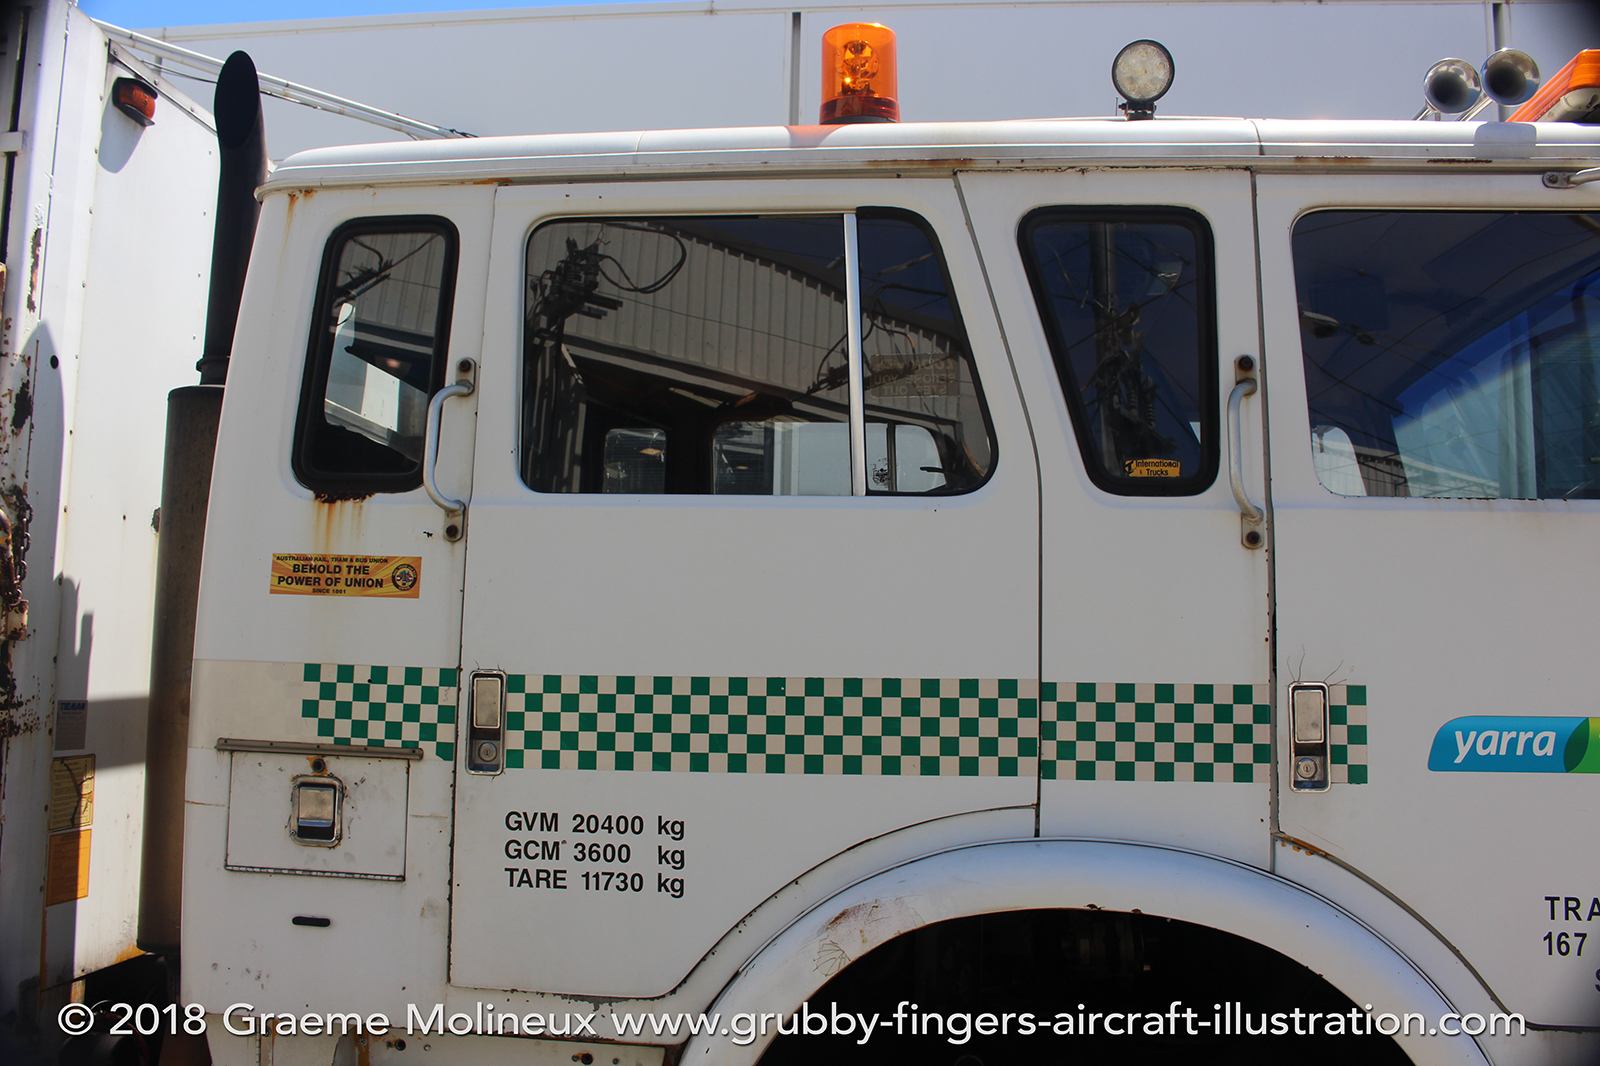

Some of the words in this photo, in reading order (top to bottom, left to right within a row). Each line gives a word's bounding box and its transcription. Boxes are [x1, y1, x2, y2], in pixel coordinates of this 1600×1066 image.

[1136, 460, 1179, 468] International
[1146, 468, 1168, 476] Trucks
[277, 575, 321, 586] POWER
[325, 577, 342, 587] OF
[345, 577, 383, 588] UNION
[292, 563, 342, 574] BEHOLD
[346, 565, 370, 575] THE
[1453, 730, 1556, 763] yarra
[504, 811, 559, 832] GVM
[571, 813, 644, 835] 20400
[657, 815, 685, 841] kg
[504, 839, 560, 860] GCM
[573, 842, 631, 863] 3600
[657, 845, 685, 870] kg
[504, 867, 567, 889] TARE
[581, 871, 644, 892] 11730
[657, 872, 685, 898] kg
[1543, 931, 1587, 956] 167
